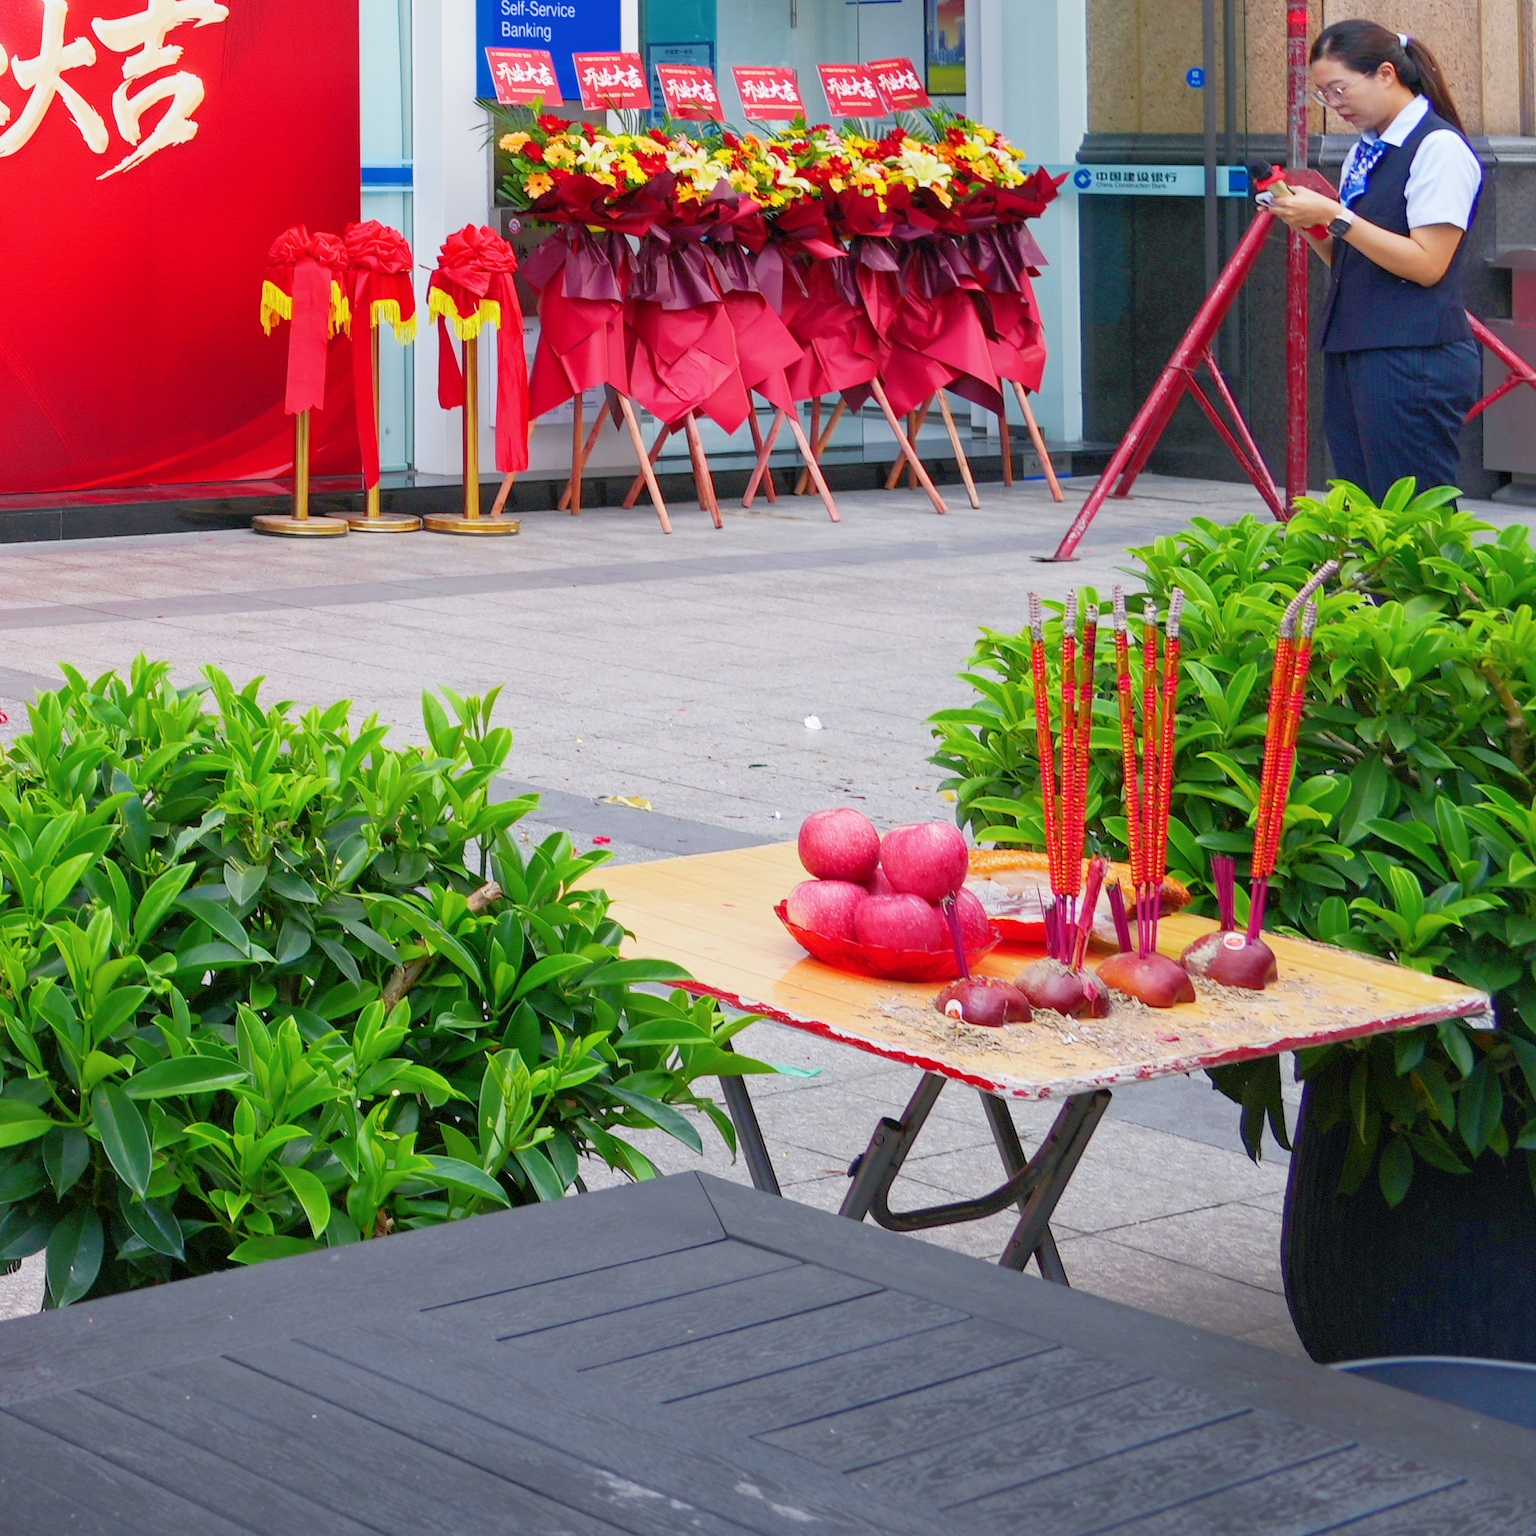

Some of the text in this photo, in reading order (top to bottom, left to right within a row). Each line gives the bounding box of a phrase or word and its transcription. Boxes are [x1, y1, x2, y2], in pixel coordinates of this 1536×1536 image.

[501, 21, 552, 43] Banking
[496, 61, 555, 87] 开业大吉
[582, 64, 643, 92] 开业大吉
[666, 78, 717, 103] 开业大吉
[741, 78, 798, 103] 开业大吉
[827, 75, 878, 100] 开业大吉
[1096, 171, 1177, 183] 中国建设银行
